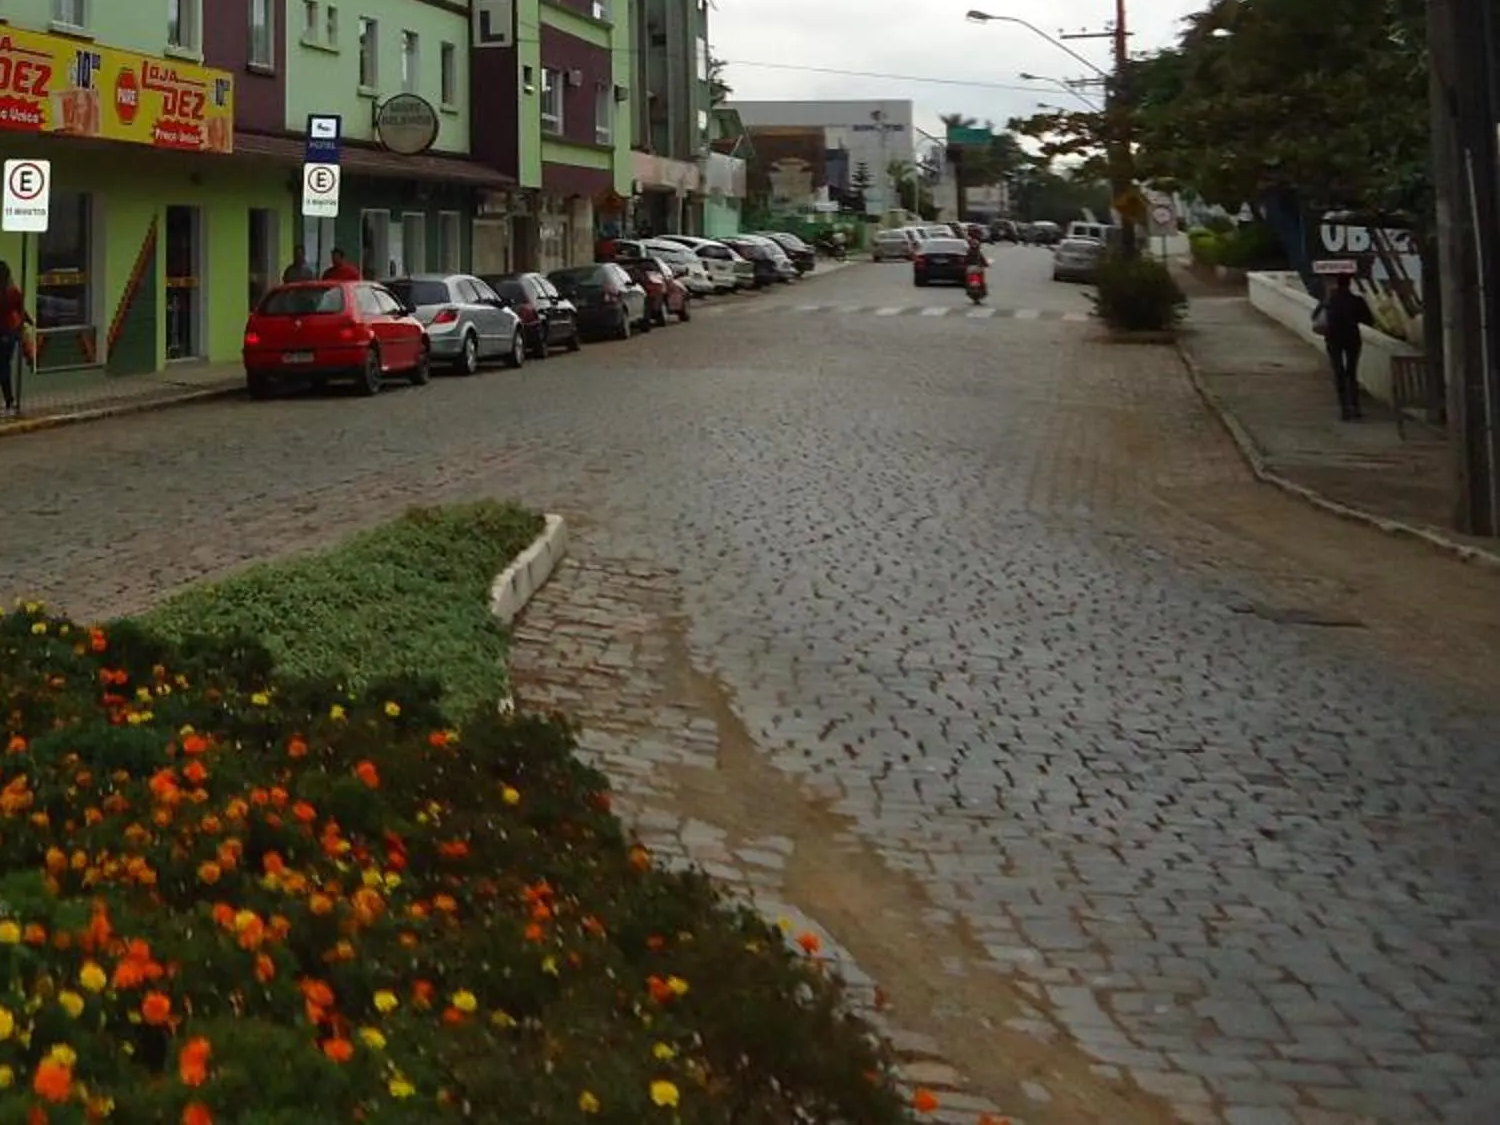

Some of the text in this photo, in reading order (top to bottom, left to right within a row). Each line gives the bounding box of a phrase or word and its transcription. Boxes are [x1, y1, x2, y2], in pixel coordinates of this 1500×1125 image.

[117, 86, 137, 106] PARE
[164, 87, 205, 120] DEZ
[19, 170, 33, 192] E
[316, 171, 327, 188] E
